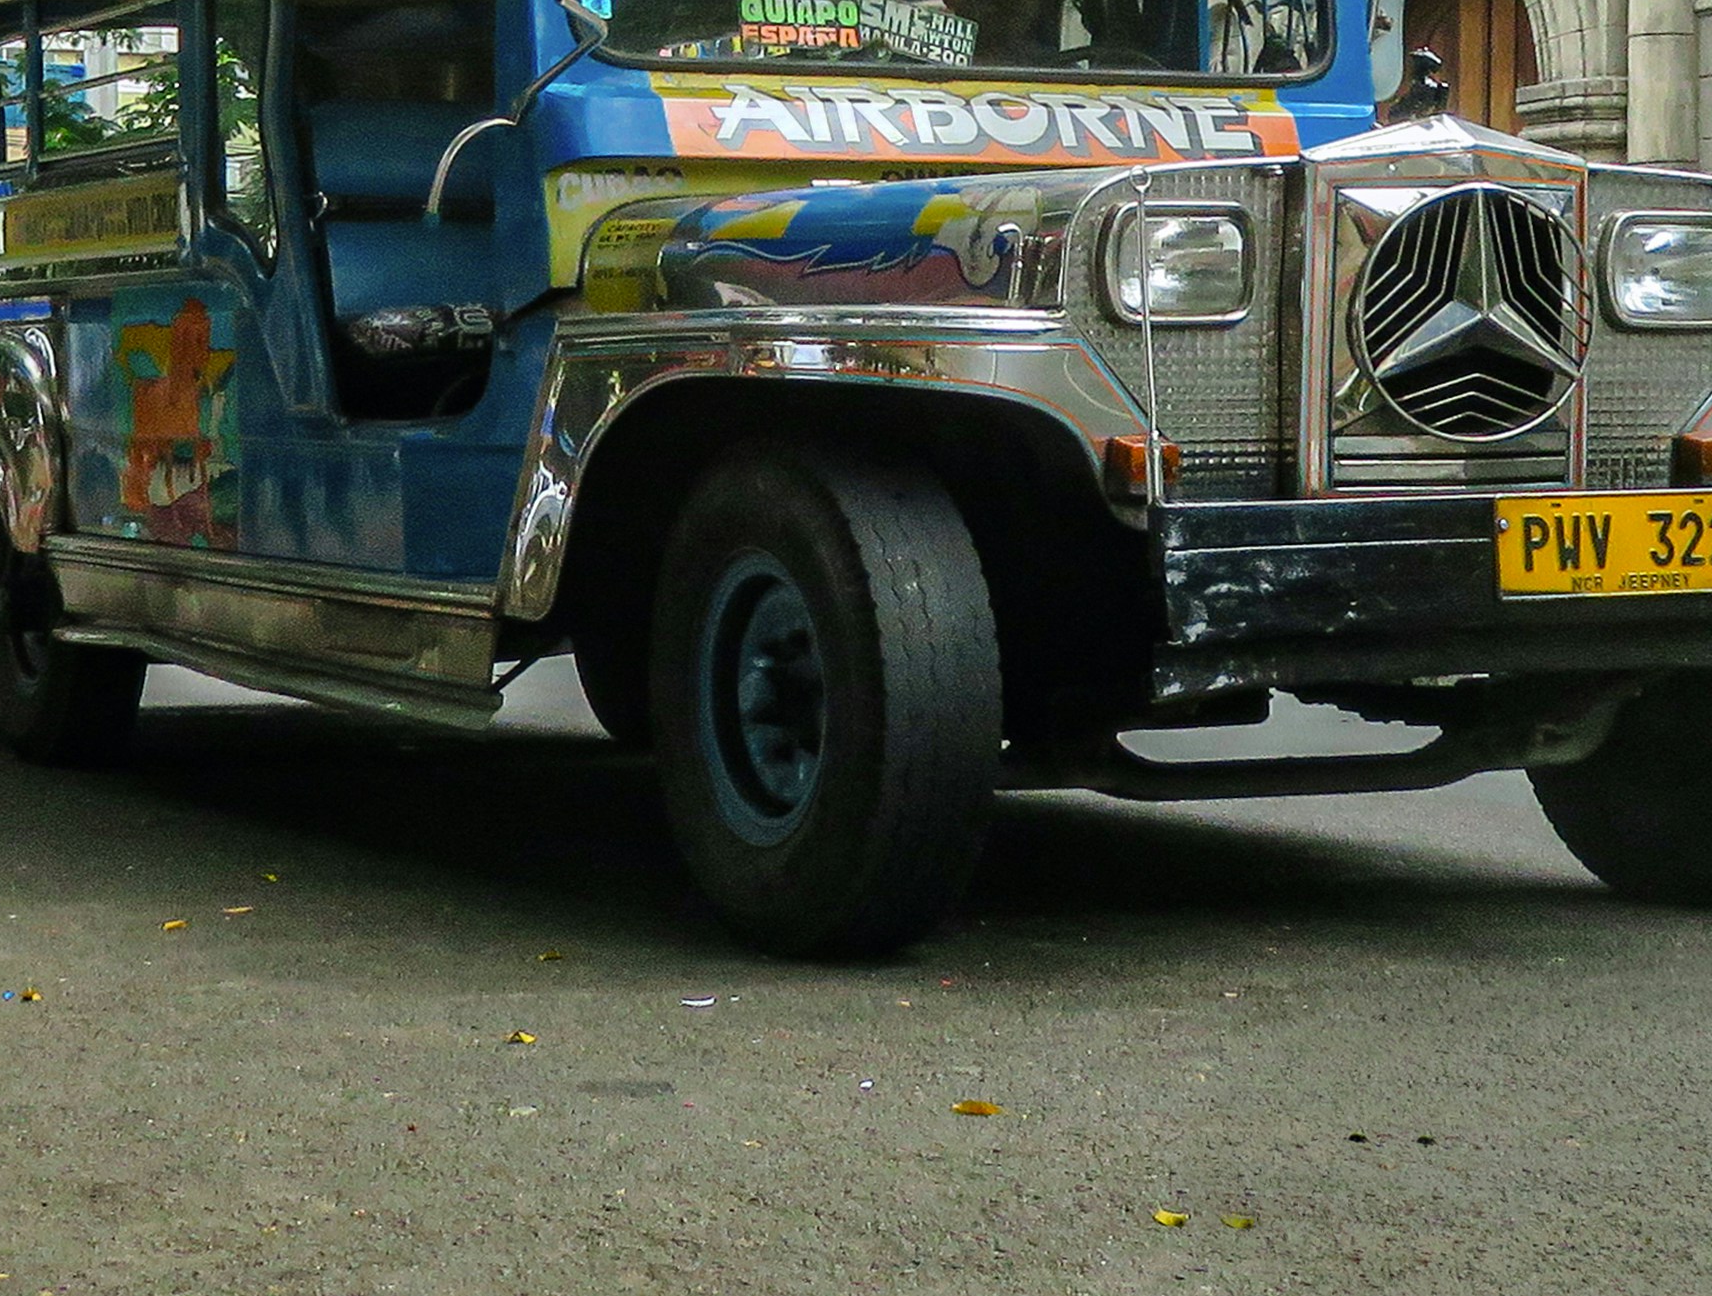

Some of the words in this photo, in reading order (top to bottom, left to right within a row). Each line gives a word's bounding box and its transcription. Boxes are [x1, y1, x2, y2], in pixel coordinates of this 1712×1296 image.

[741, 23, 859, 48] ESPAÑA
[710, 84, 1260, 155] AIRBORNE
[1522, 511, 1612, 573] PWV
[1571, 576, 1603, 592] NCR
[1618, 572, 1692, 590] JEEPNEY
